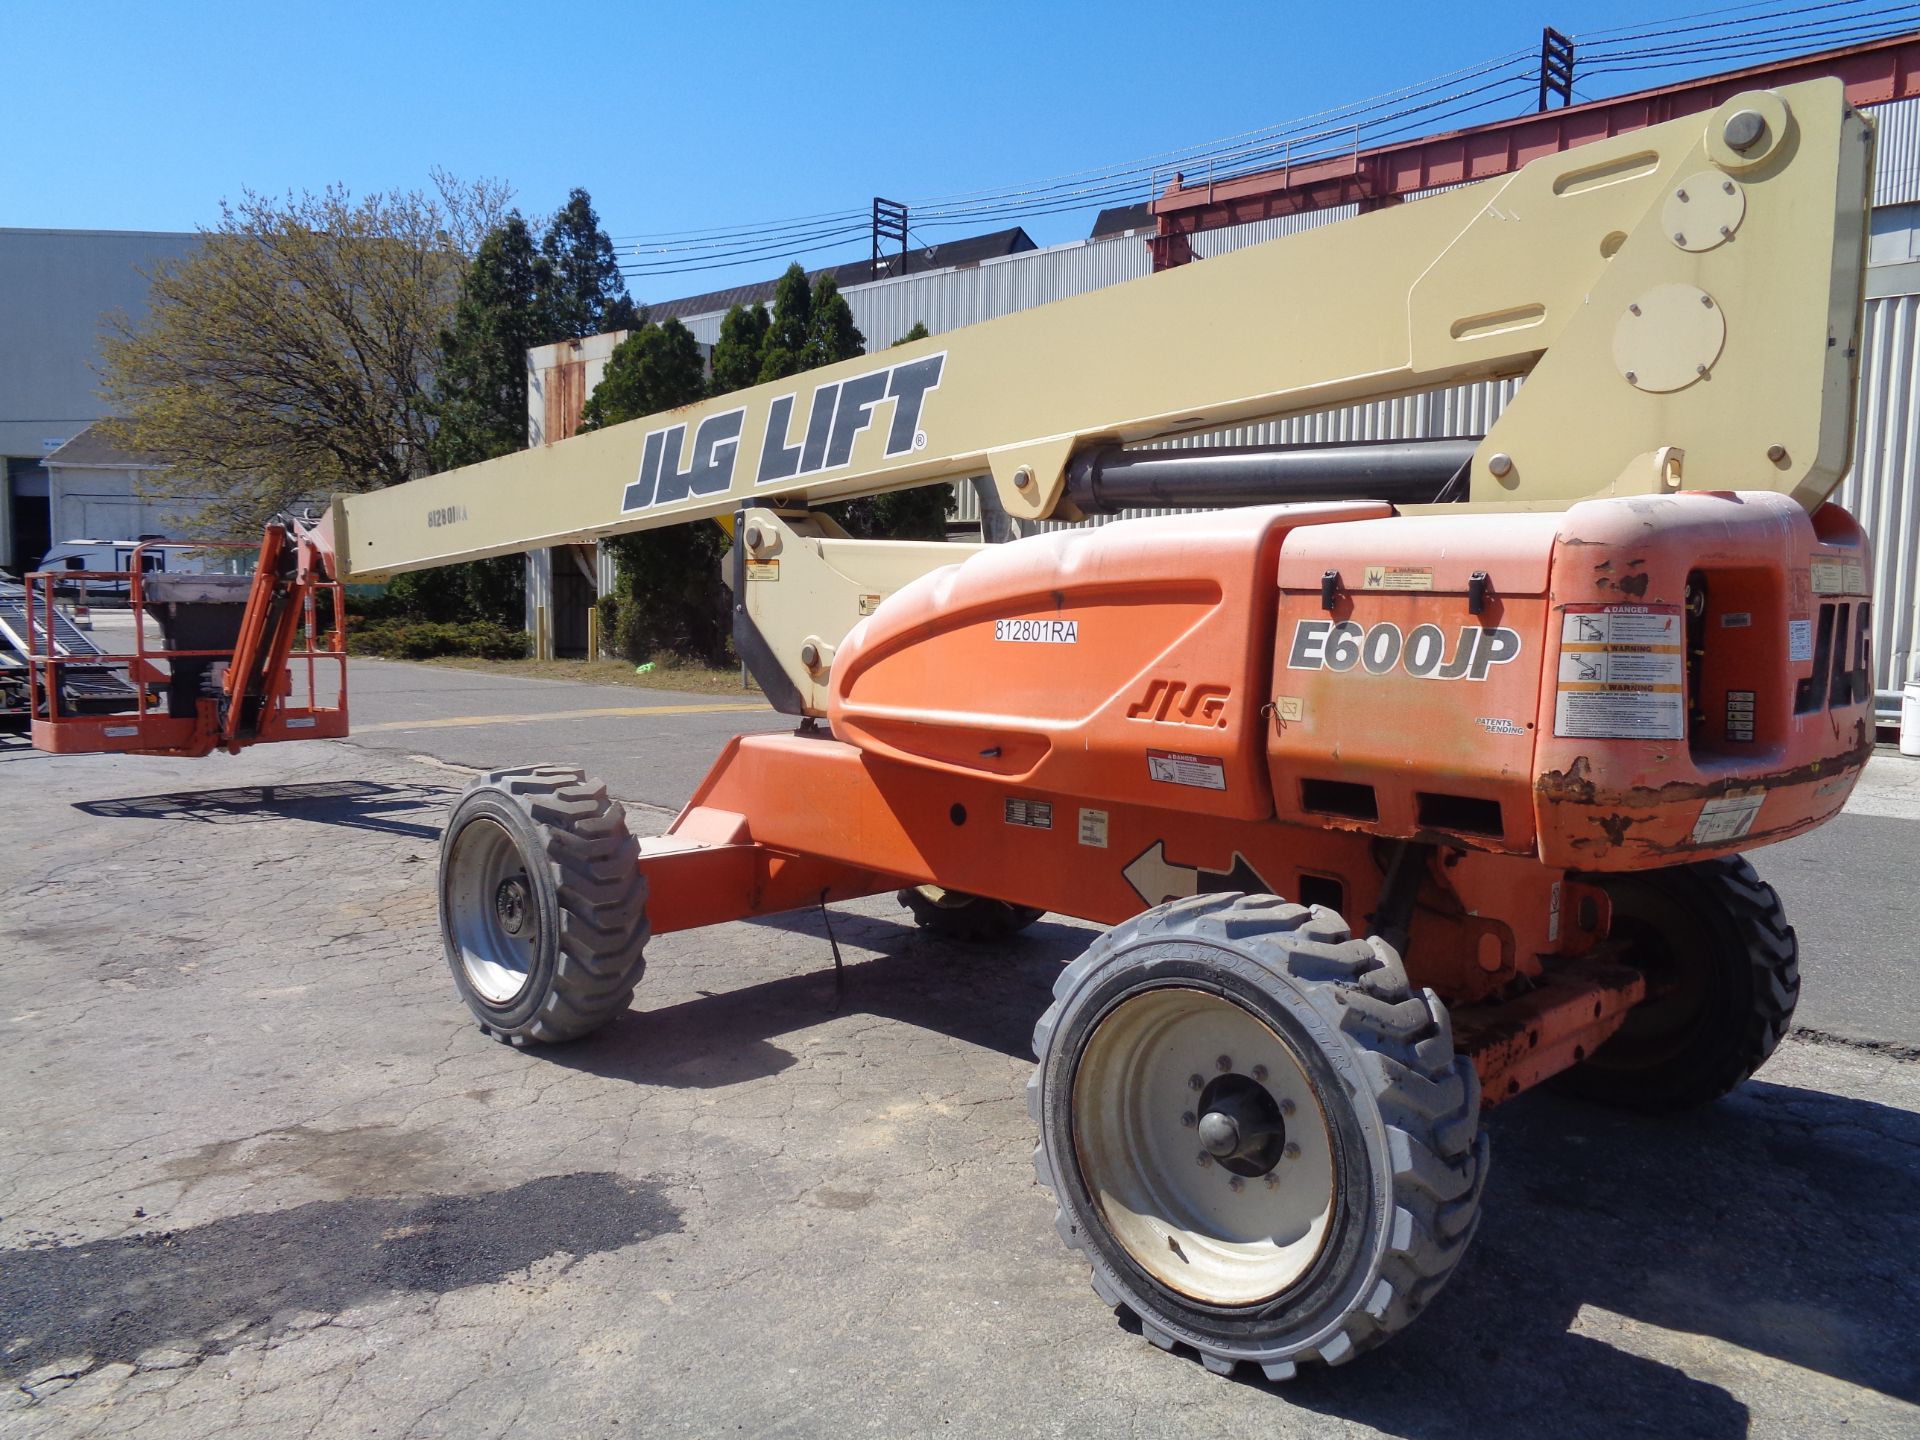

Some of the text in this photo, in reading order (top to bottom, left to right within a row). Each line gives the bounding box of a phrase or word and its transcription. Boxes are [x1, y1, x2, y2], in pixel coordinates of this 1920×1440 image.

[621, 350, 948, 514] JLG LIFT
[995, 620, 1077, 642] 812801RA
[1288, 620, 1522, 681] E600JP
[1608, 684, 1654, 692] WARNING
[1476, 718, 1512, 726] PATENTS
[1486, 726, 1524, 735] PENDING
